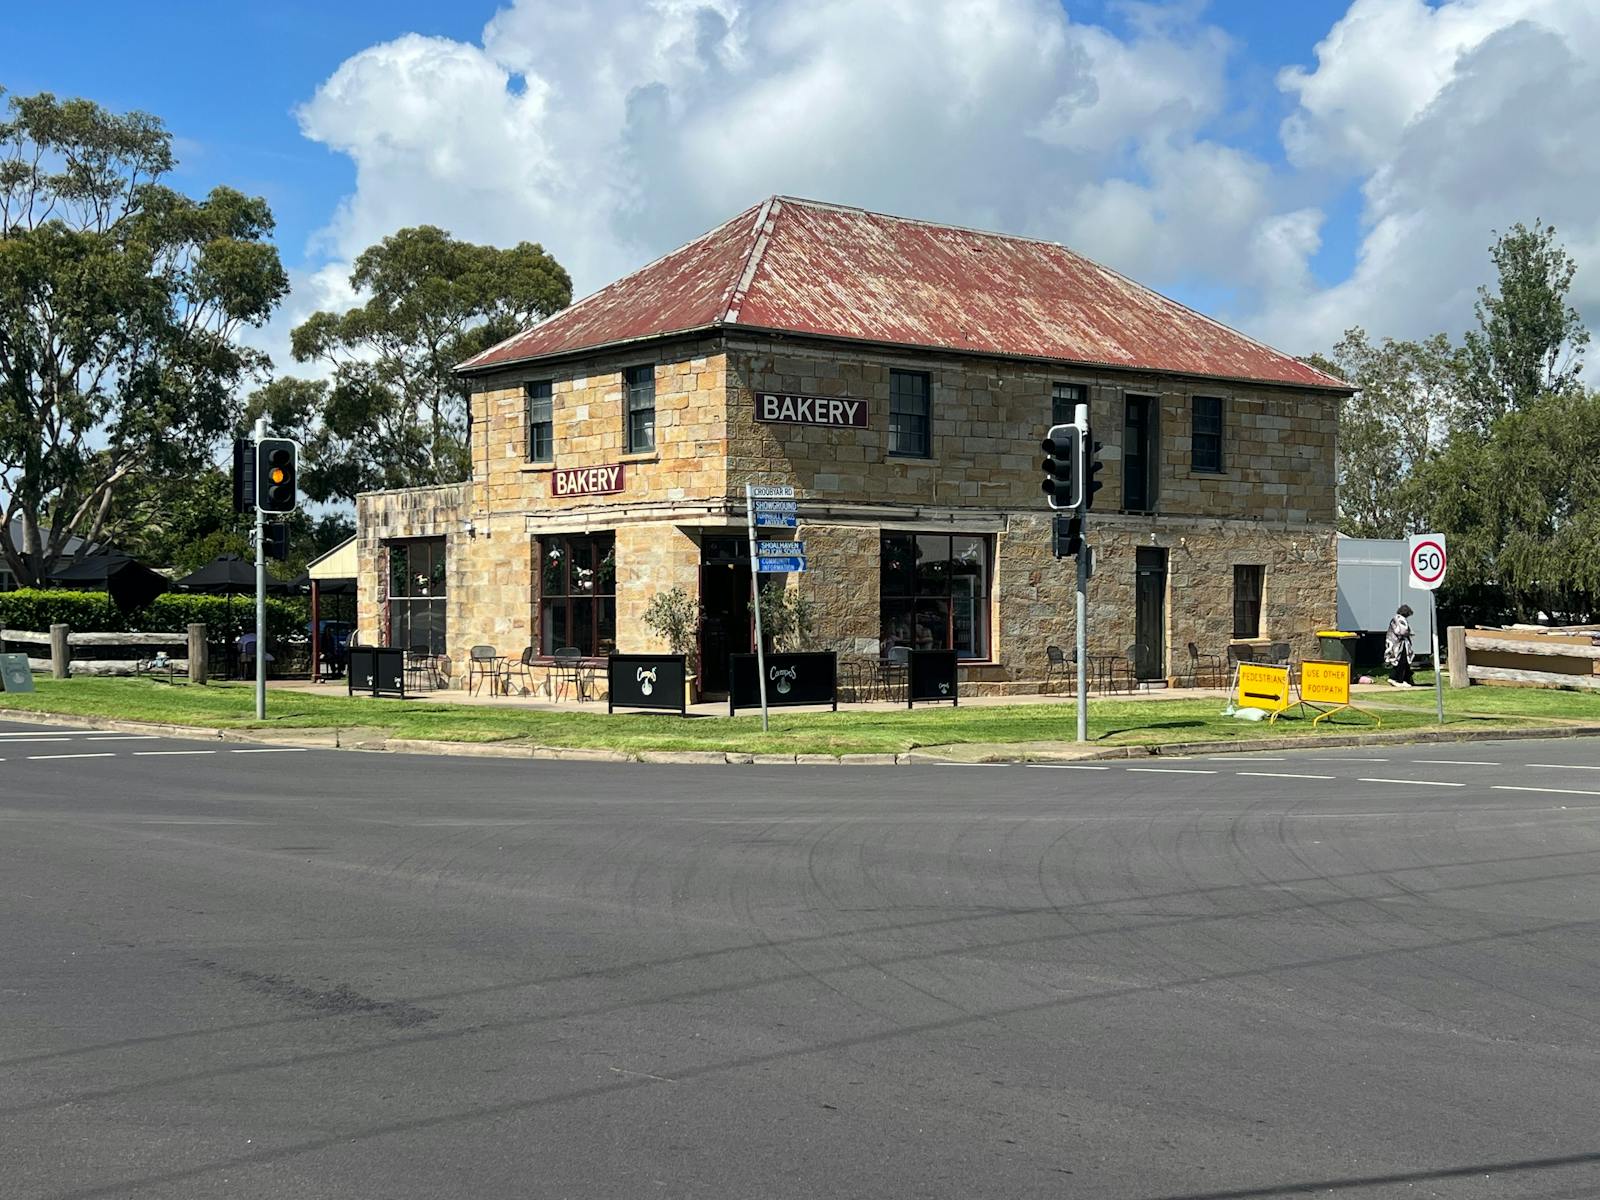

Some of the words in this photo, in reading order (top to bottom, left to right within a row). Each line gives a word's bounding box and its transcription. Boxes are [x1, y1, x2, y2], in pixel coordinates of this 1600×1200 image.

[763, 395, 859, 425] BAKERY
[556, 466, 620, 494] BAKERY
[785, 488, 793, 496] RD
[755, 501, 797, 511] SHOWGROUND
[1418, 553, 1440, 571] 50
[1242, 672, 1286, 684] PEDESTRIANS
[1306, 669, 1319, 678] USE
[1323, 670, 1345, 680] OTHER
[1307, 684, 1343, 694] FOOTPATH
